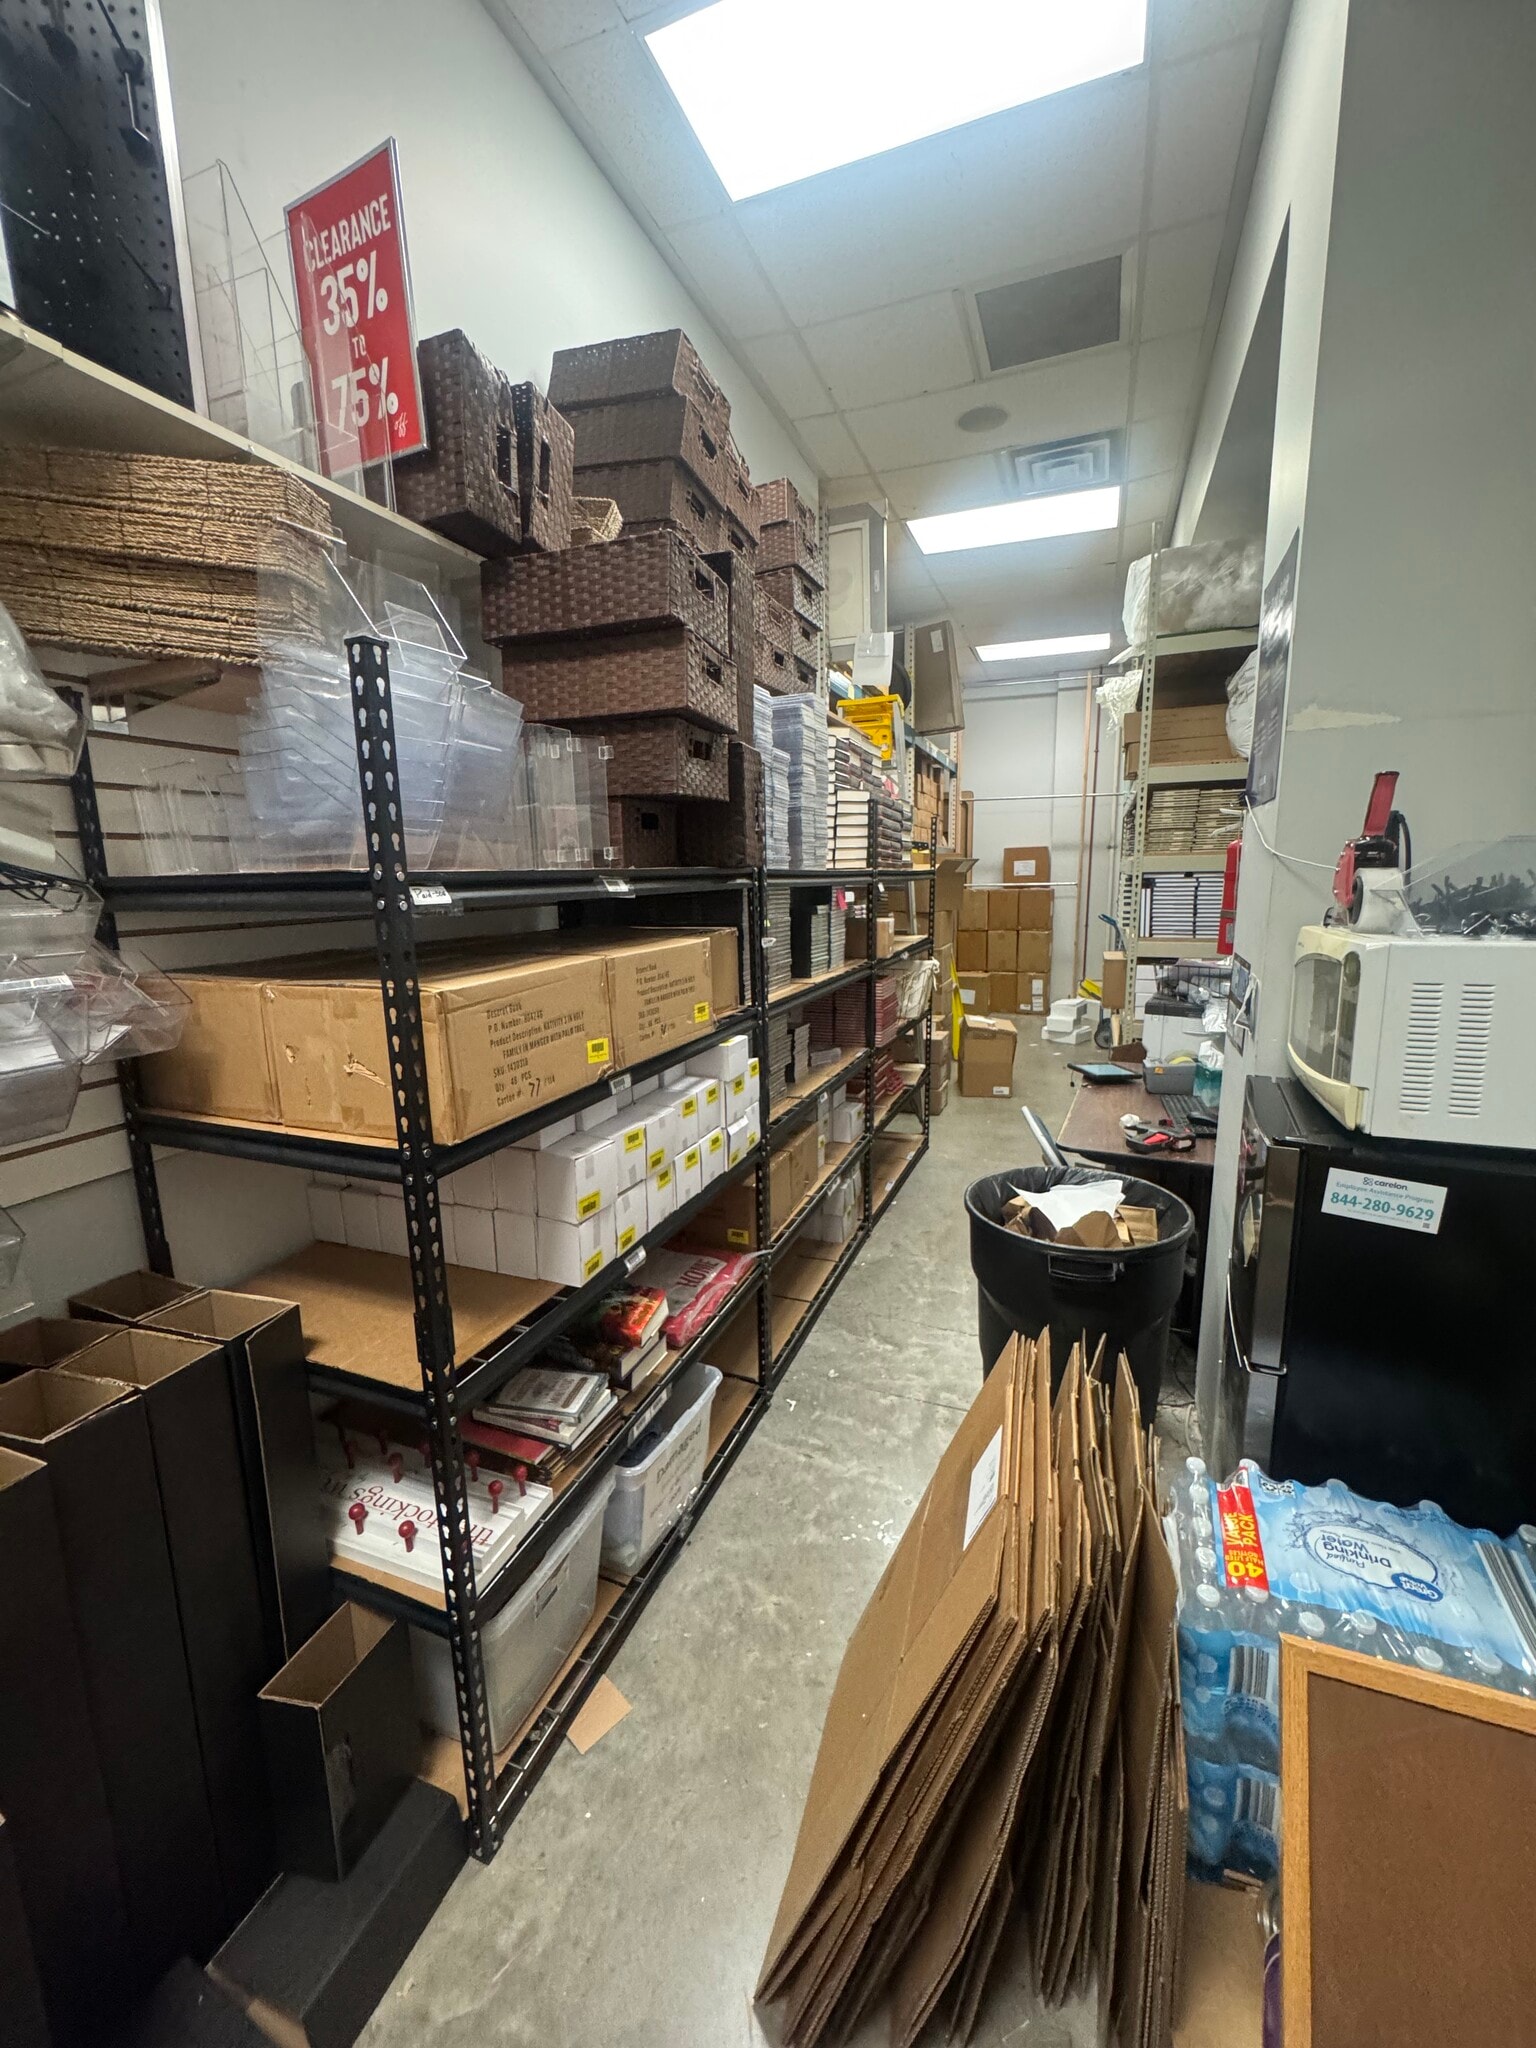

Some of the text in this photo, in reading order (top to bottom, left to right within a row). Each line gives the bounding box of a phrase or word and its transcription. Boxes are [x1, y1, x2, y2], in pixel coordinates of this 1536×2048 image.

[304, 193, 391, 272] CLEARANCE
[320, 250, 388, 336] 35%
[352, 334, 367, 359] TO
[331, 357, 399, 433] 75%
[1374, 1178, 1408, 1191] carelon
[1330, 1191, 1435, 1222] 844-280-9629
[349, 1485, 439, 1529] tockings
[1239, 1513, 1258, 1547] PACK
[1319, 1533, 1370, 1554] Water
[1227, 1561, 1264, 1577] 40
[1322, 1540, 1392, 1569] Drinking
